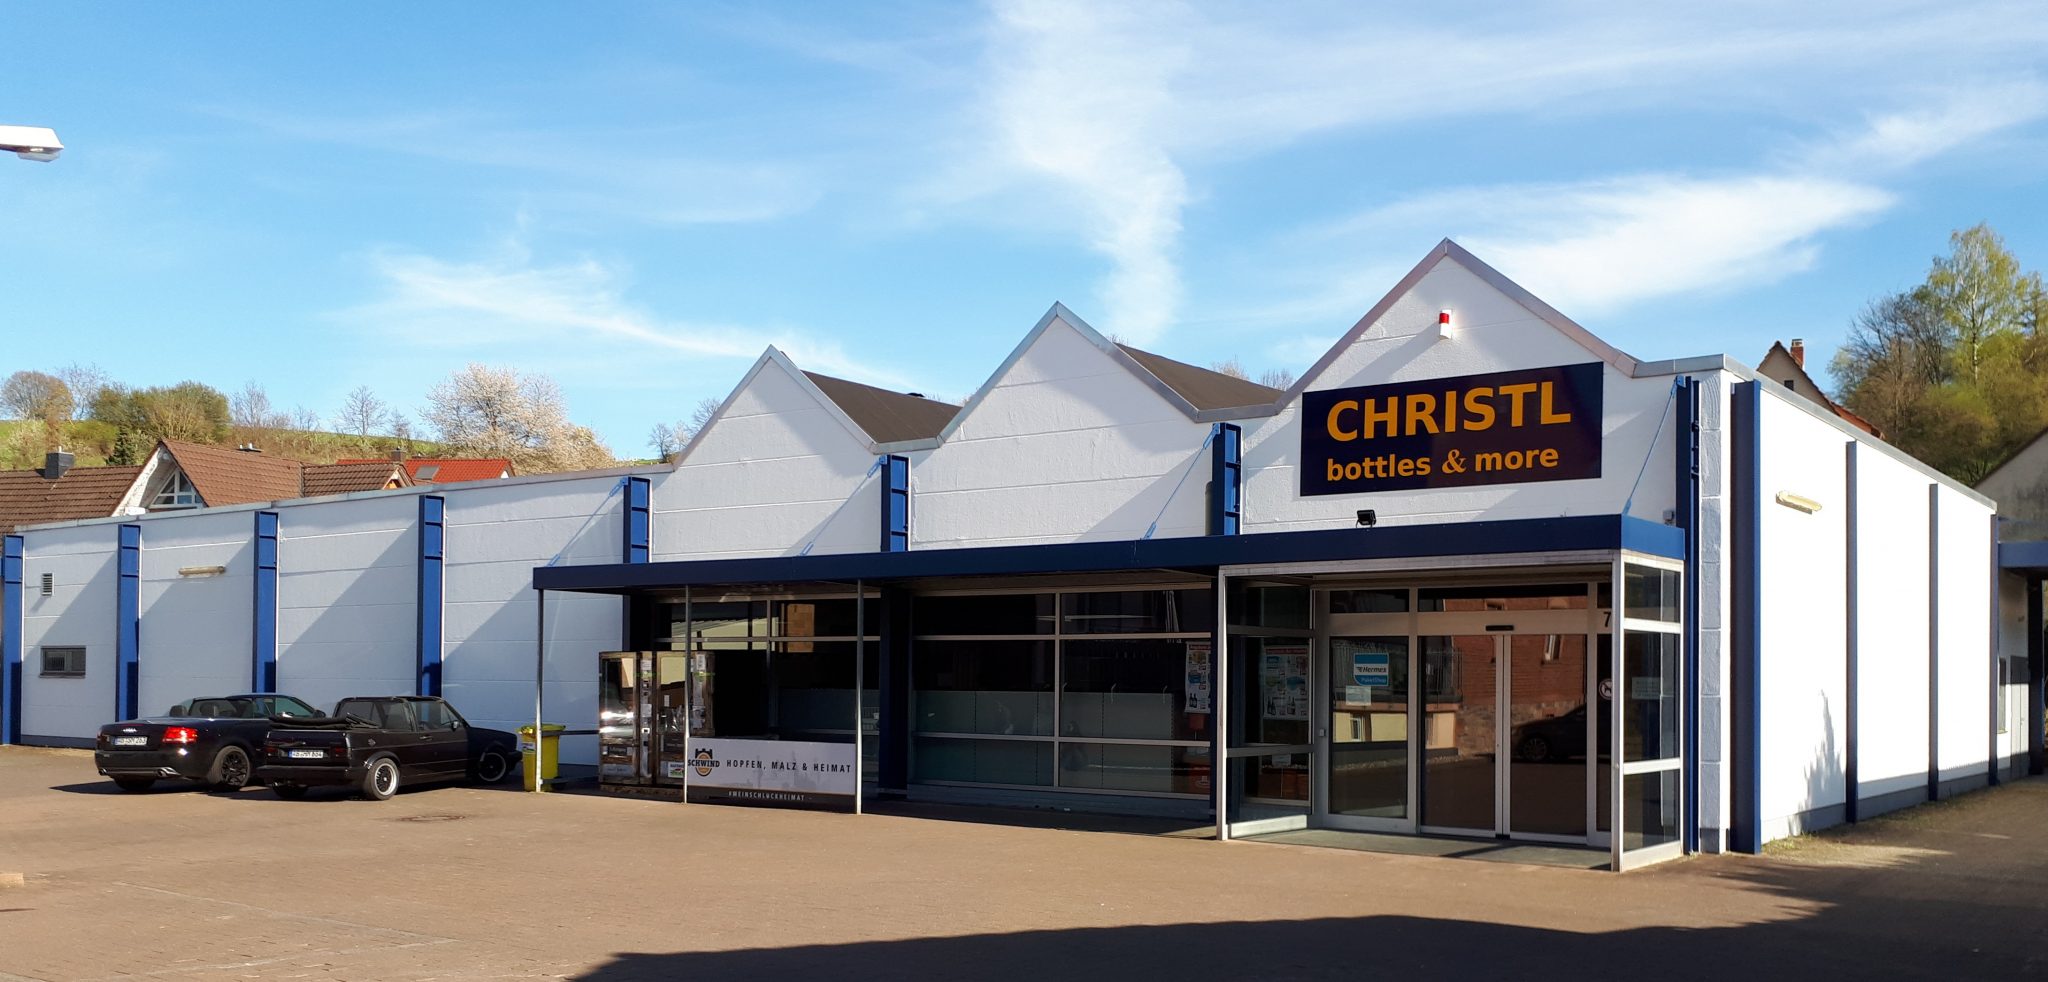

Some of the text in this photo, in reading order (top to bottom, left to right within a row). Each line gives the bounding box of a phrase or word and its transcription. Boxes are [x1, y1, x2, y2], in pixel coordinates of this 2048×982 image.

[1327, 381, 1571, 442] CHRISTL
[1327, 448, 1559, 482] bottles & more
[1603, 611, 1612, 628] 7
[688, 759, 720, 768] SCHWIND
[726, 760, 851, 773] HOPFEN, MALZ & HEIMAT
